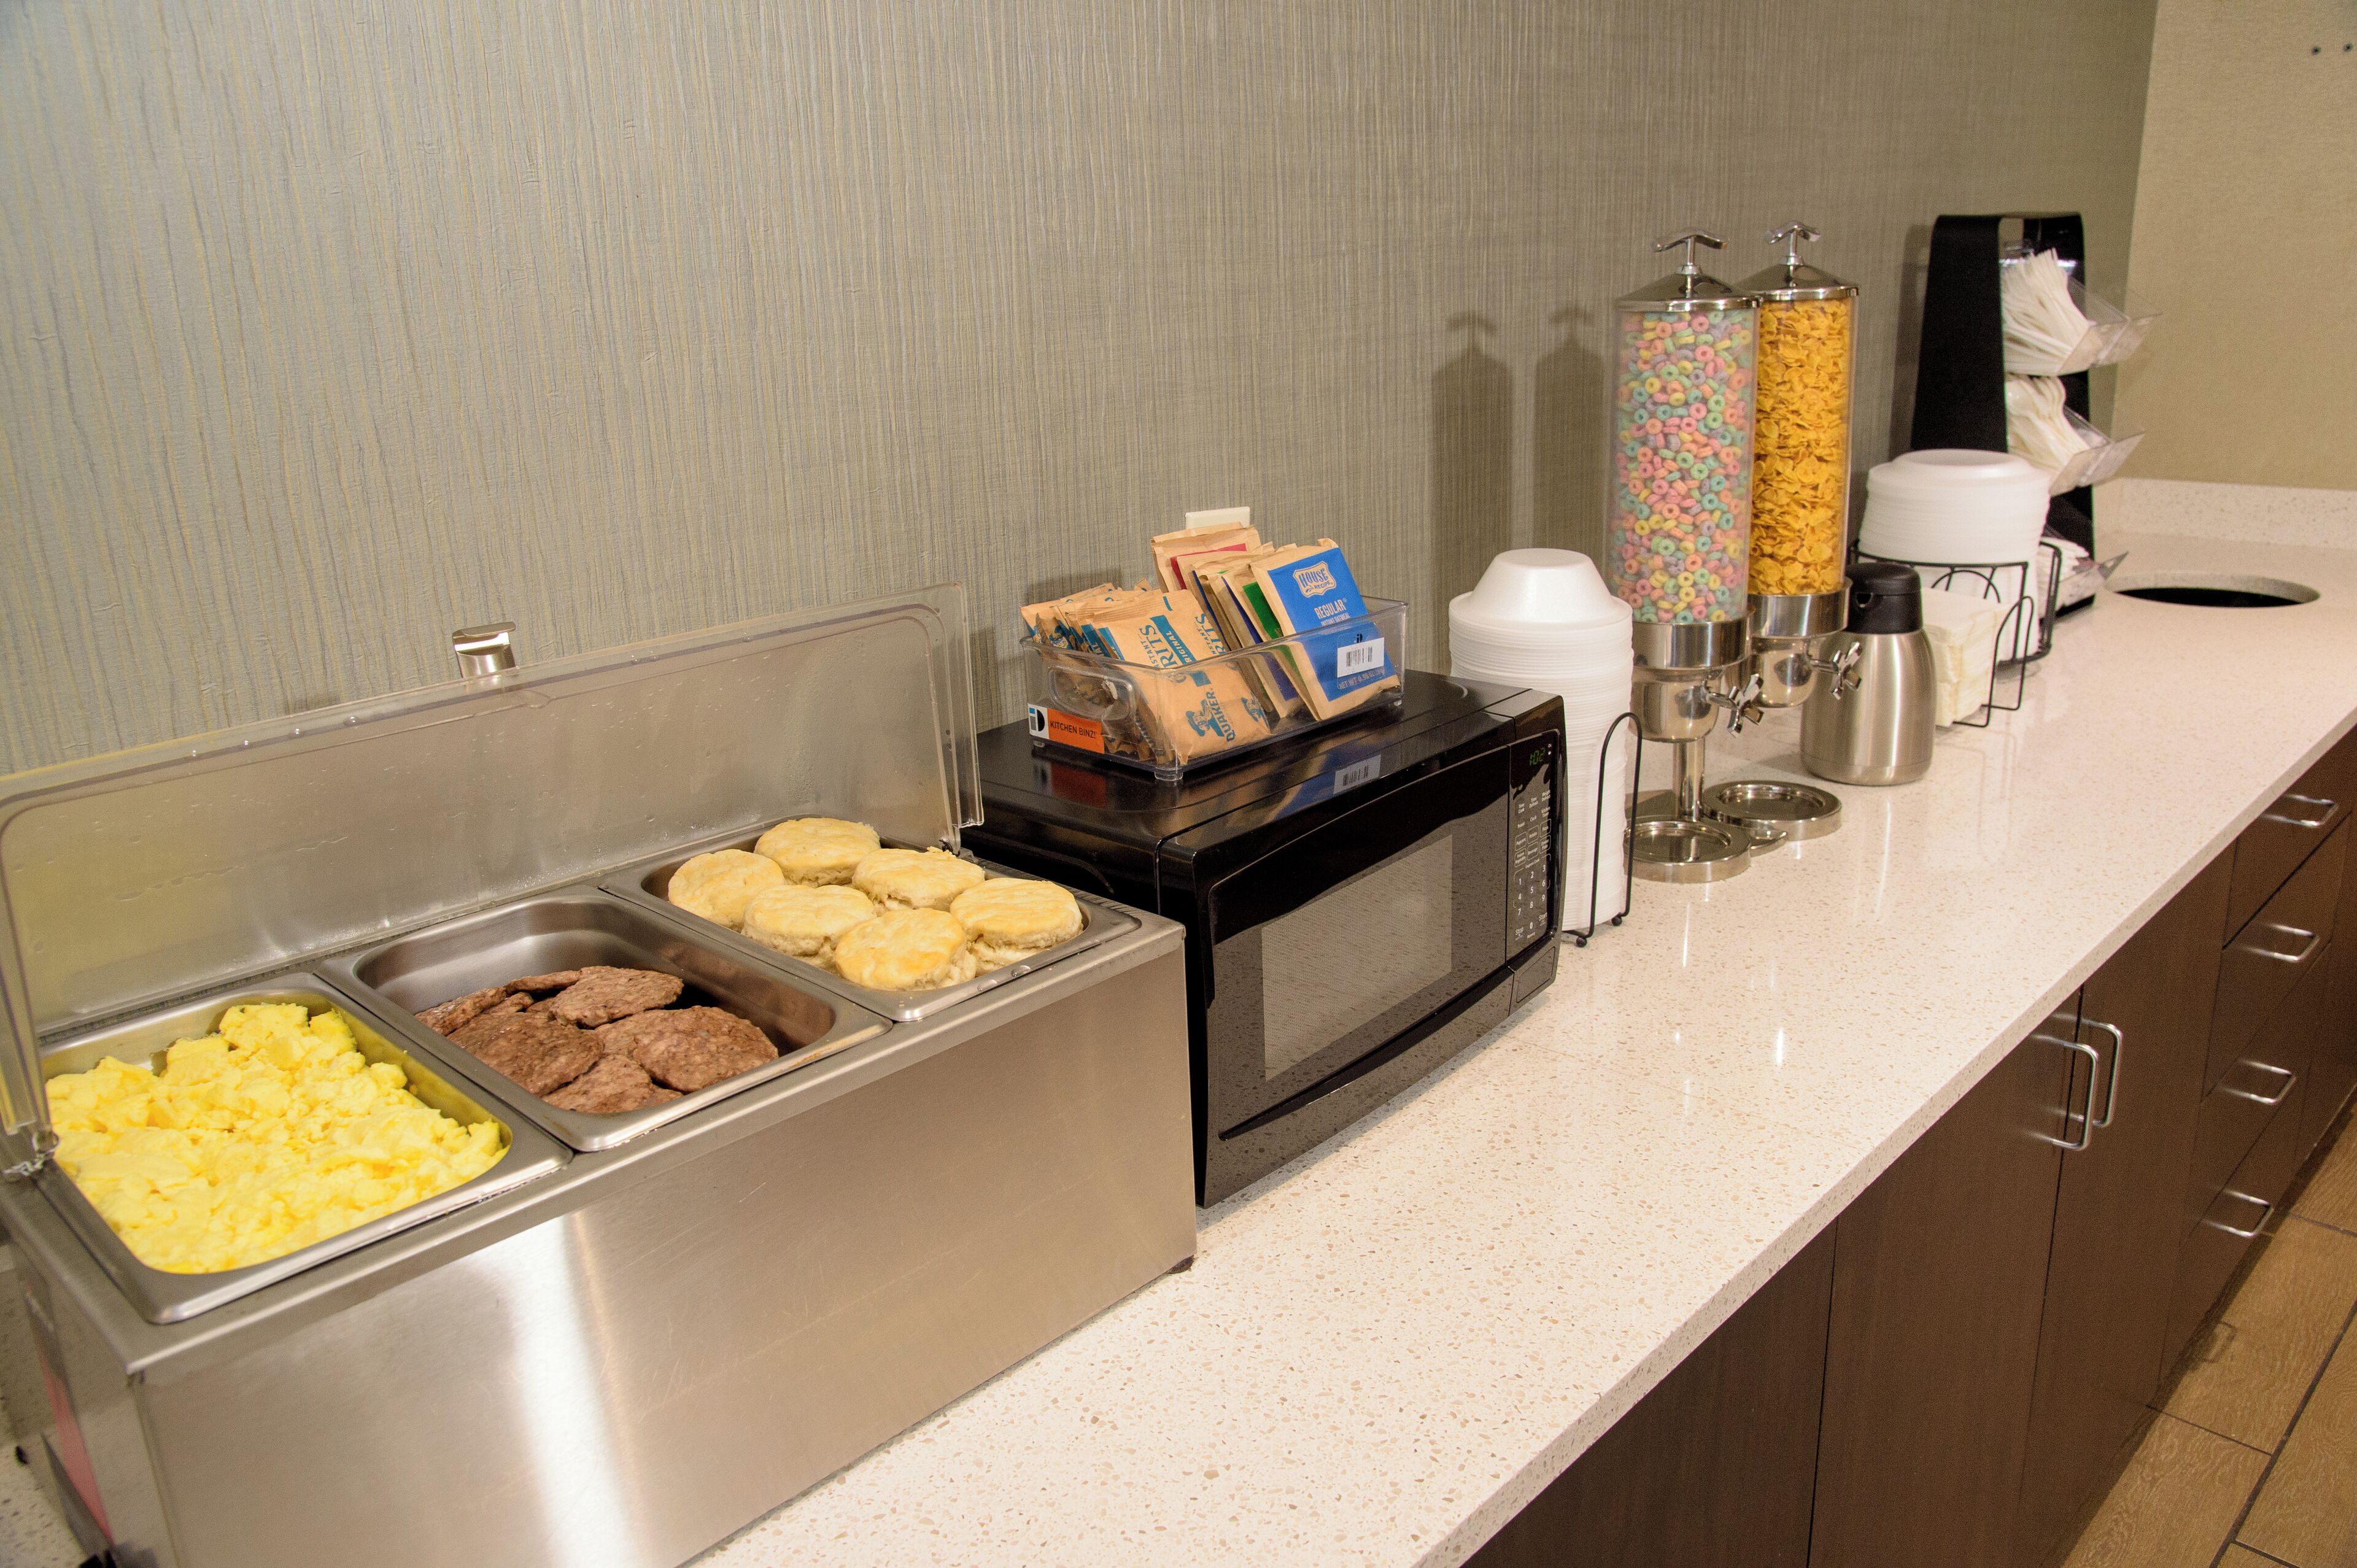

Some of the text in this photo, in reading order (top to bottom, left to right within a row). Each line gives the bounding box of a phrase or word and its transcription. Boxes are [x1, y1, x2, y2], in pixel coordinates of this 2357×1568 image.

[1298, 567, 1329, 588] HOUSE
[1314, 581, 1331, 590] RECIPE
[1314, 598, 1346, 620] REGULAR
[1334, 612, 1351, 623] OATMEAL
[1139, 624, 1183, 676] RITS
[1166, 630, 1193, 663] RIGINAL
[1198, 628, 1217, 655] NSTANT
[1140, 640, 1160, 668] NSTANT
[1338, 681, 1348, 689] NET
[1206, 691, 1236, 742] QUAKER
[1050, 720, 1096, 739] KITCHEN BINZ!
[1539, 912, 1547, 921] Start
[1515, 927, 1523, 935] Stop
